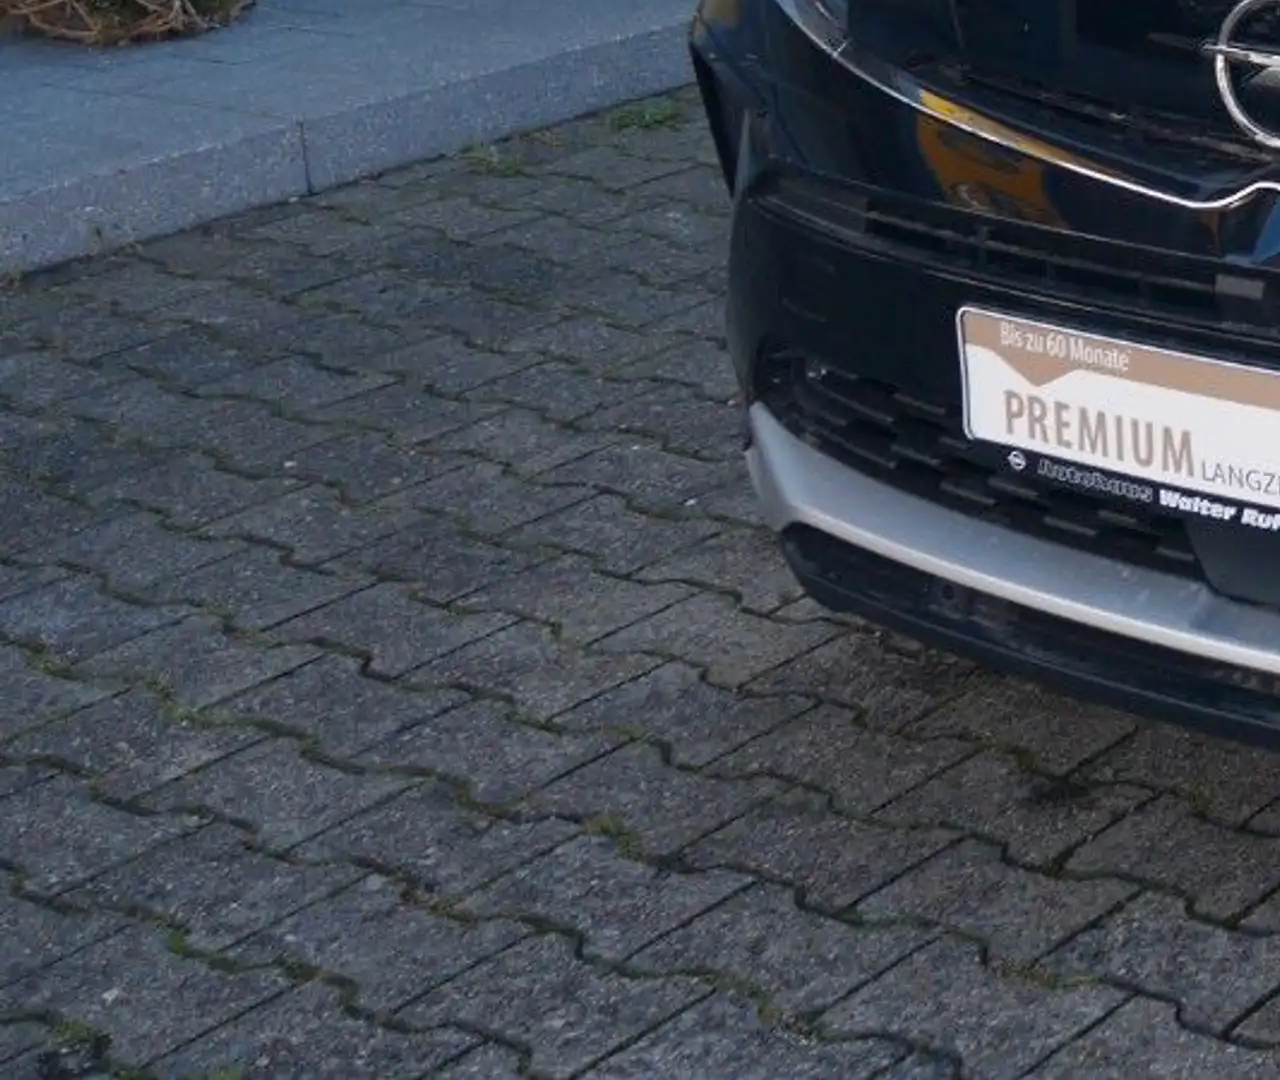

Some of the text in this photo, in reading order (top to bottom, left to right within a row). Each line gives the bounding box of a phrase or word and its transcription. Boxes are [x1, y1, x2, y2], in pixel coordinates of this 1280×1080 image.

[1000, 322, 1023, 347] Bis
[1026, 333, 1044, 353] zu
[1046, 331, 1066, 358] 60
[1004, 389, 1195, 478] PREMIUM
[1037, 457, 1154, 503] Autohaus
[1159, 489, 1237, 520] Walter
